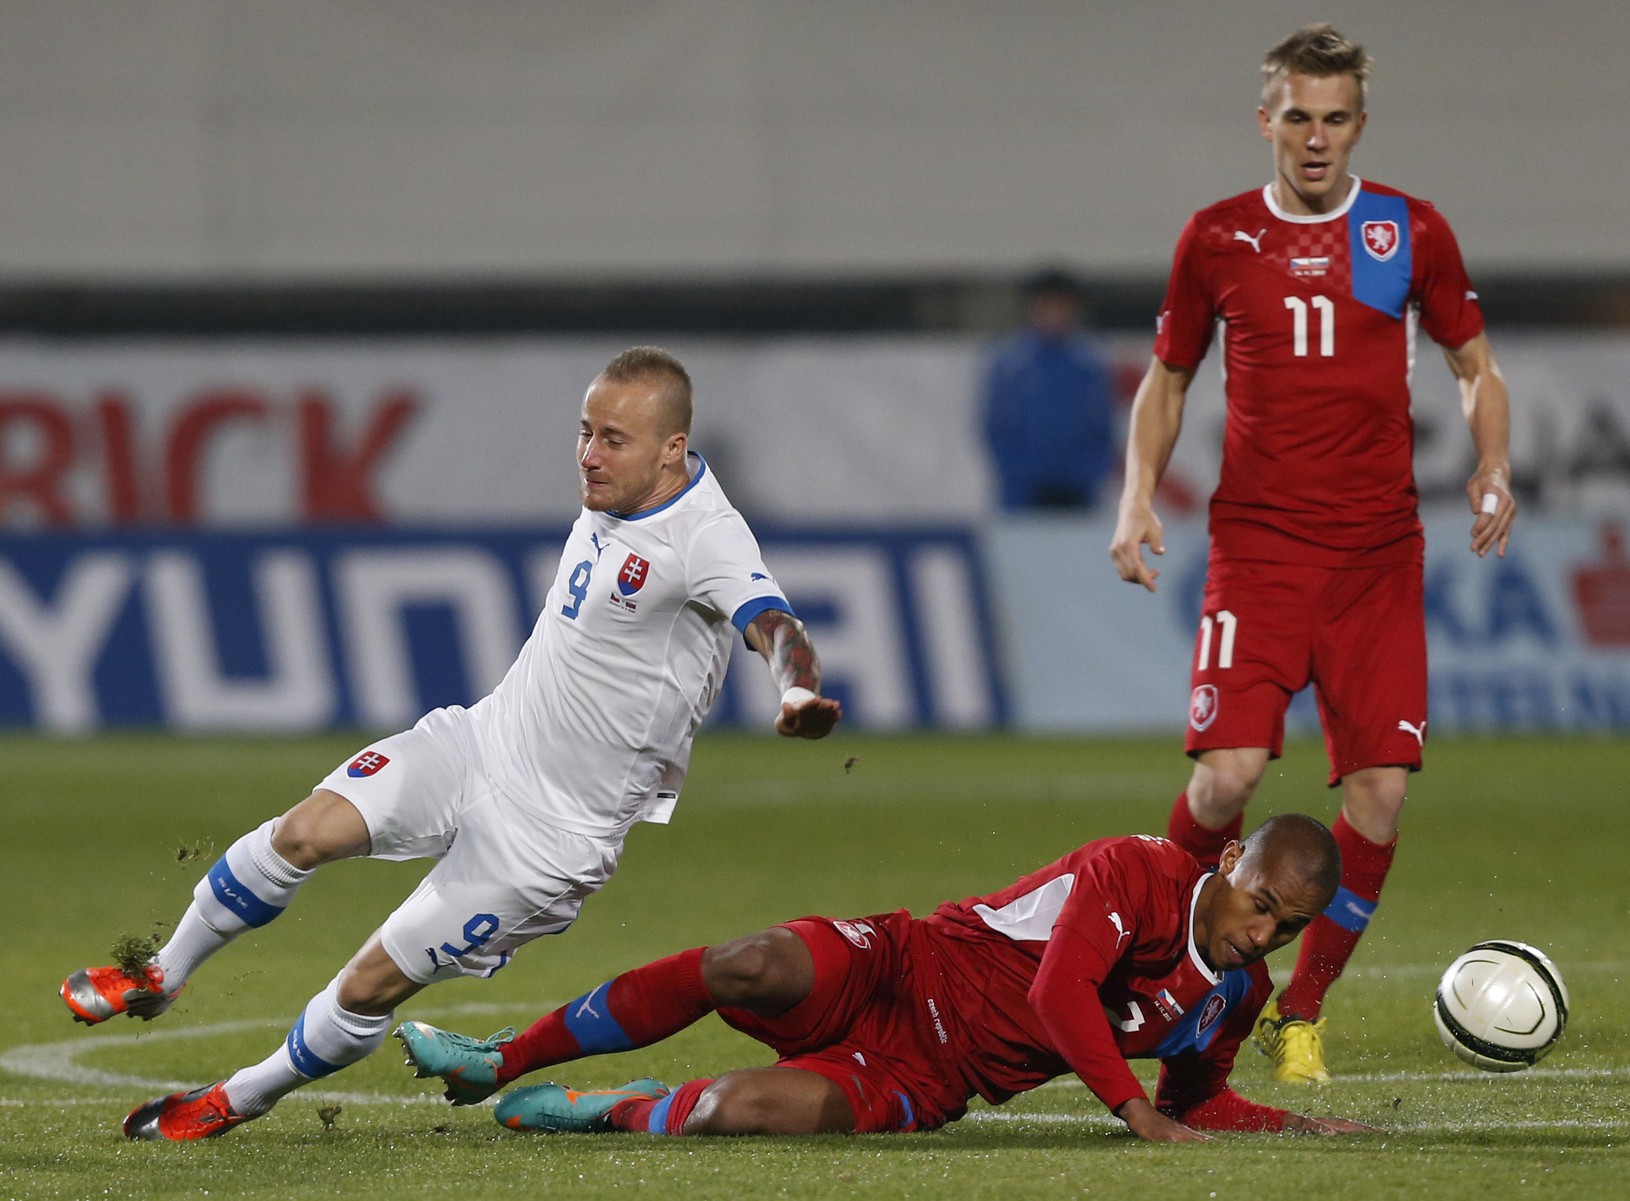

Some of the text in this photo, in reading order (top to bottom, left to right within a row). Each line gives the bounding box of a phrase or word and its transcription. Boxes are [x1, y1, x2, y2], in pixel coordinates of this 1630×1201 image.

[1284, 295, 1334, 357] 11
[0, 387, 422, 526] RICK
[561, 560, 592, 620] 9
[1198, 610, 1238, 671] 11
[440, 913, 500, 957] 9
